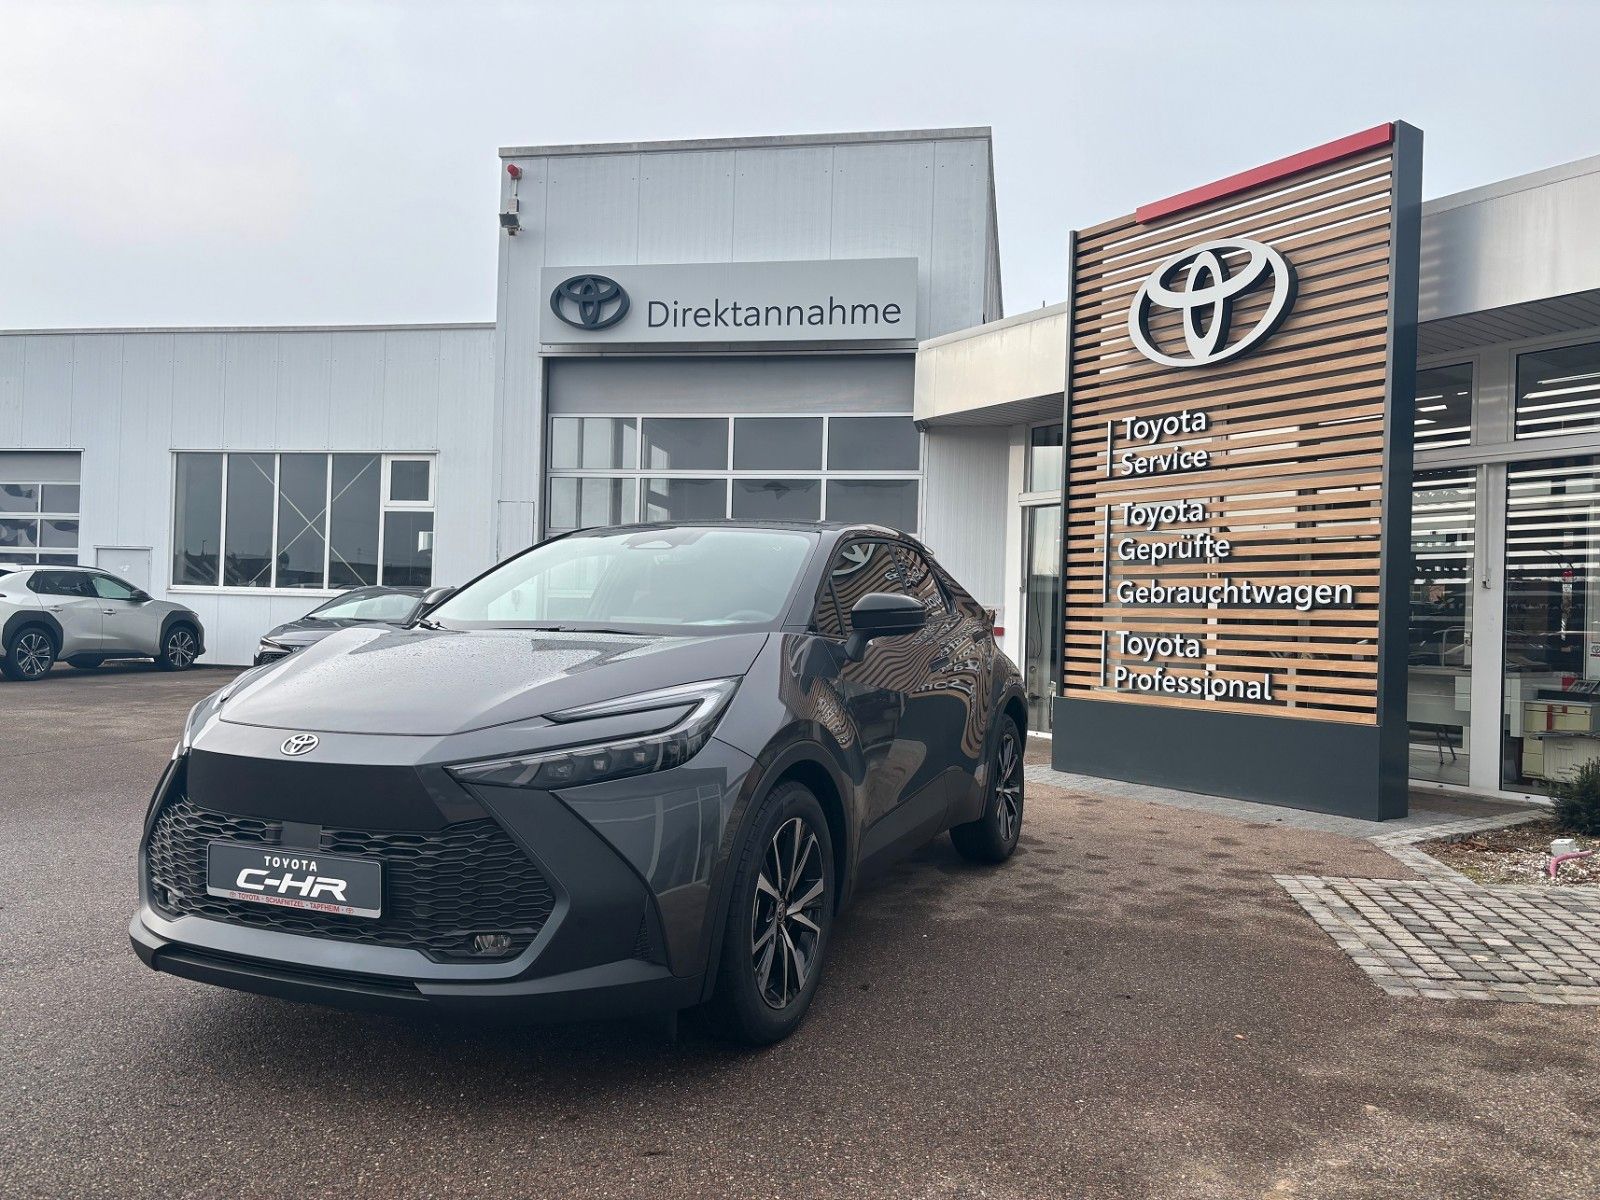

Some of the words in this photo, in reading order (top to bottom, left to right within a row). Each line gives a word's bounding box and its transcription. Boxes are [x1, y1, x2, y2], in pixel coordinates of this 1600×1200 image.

[647, 296, 902, 328] Direktannahme
[1122, 410, 1207, 444] Toyota
[1120, 446, 1209, 476] Service
[1119, 499, 1205, 531] Toyota
[1117, 533, 1231, 566] Geprüfte
[1116, 578, 1353, 611] Gebrauchtwagen
[1115, 631, 1201, 662] Toyota
[1114, 666, 1273, 701] Professional
[264, 855, 318, 872] TOYOTA
[236, 868, 348, 902] C-HR
[238, 892, 261, 901] TOYOTA
[309, 902, 340, 913] TAPFHEIM
